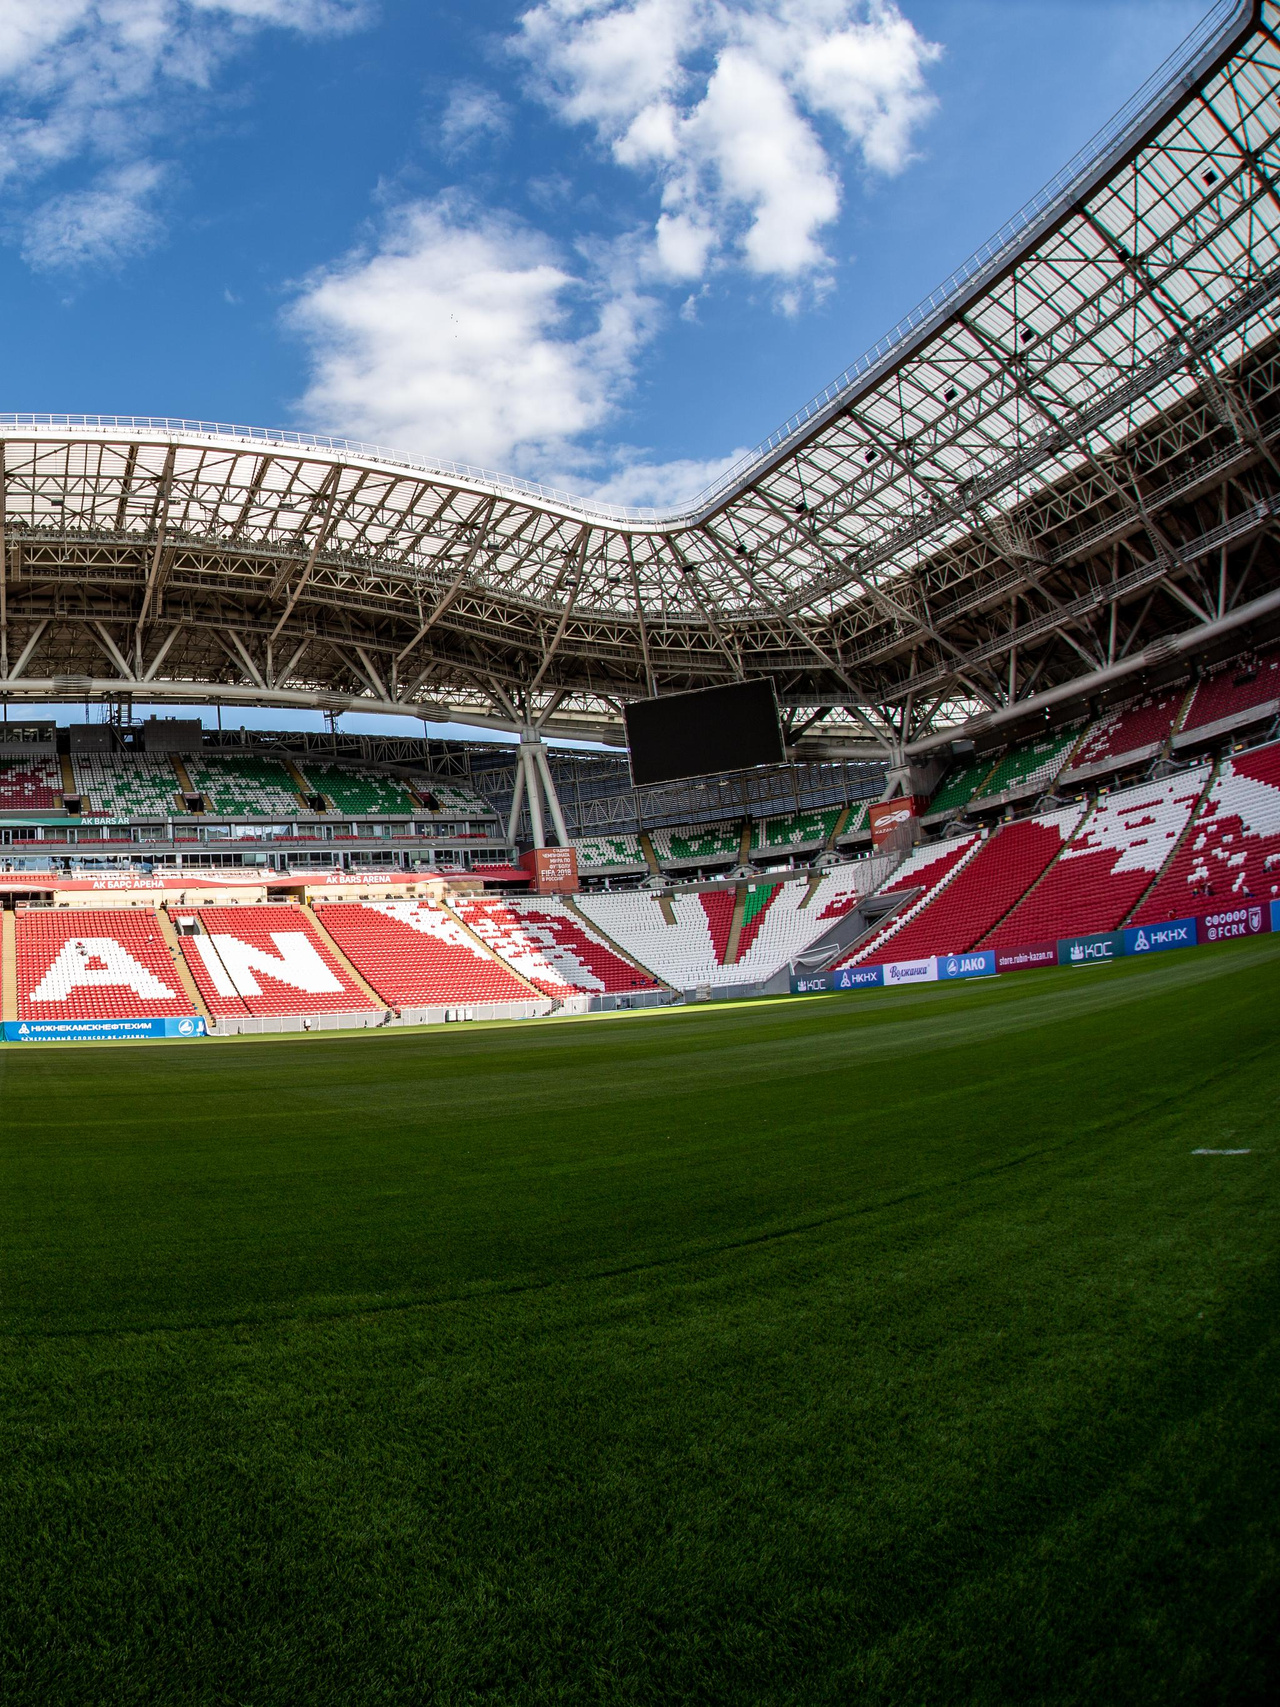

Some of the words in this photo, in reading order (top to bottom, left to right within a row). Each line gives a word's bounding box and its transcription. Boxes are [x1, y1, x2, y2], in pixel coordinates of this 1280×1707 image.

[541, 869, 556, 877] FIFA
[93, 881, 106, 889] АК
[107, 880, 132, 889] БАРС
[133, 880, 165, 888] АРЕНА
[326, 876, 338, 884] AK
[339, 876, 361, 884] BARS
[363, 875, 391, 883] ARENA
[1207, 922, 1246, 940] @FCRK
[960, 957, 986, 972] JAKO
[999, 951, 1054, 966] store.rubin-kazan.ru
